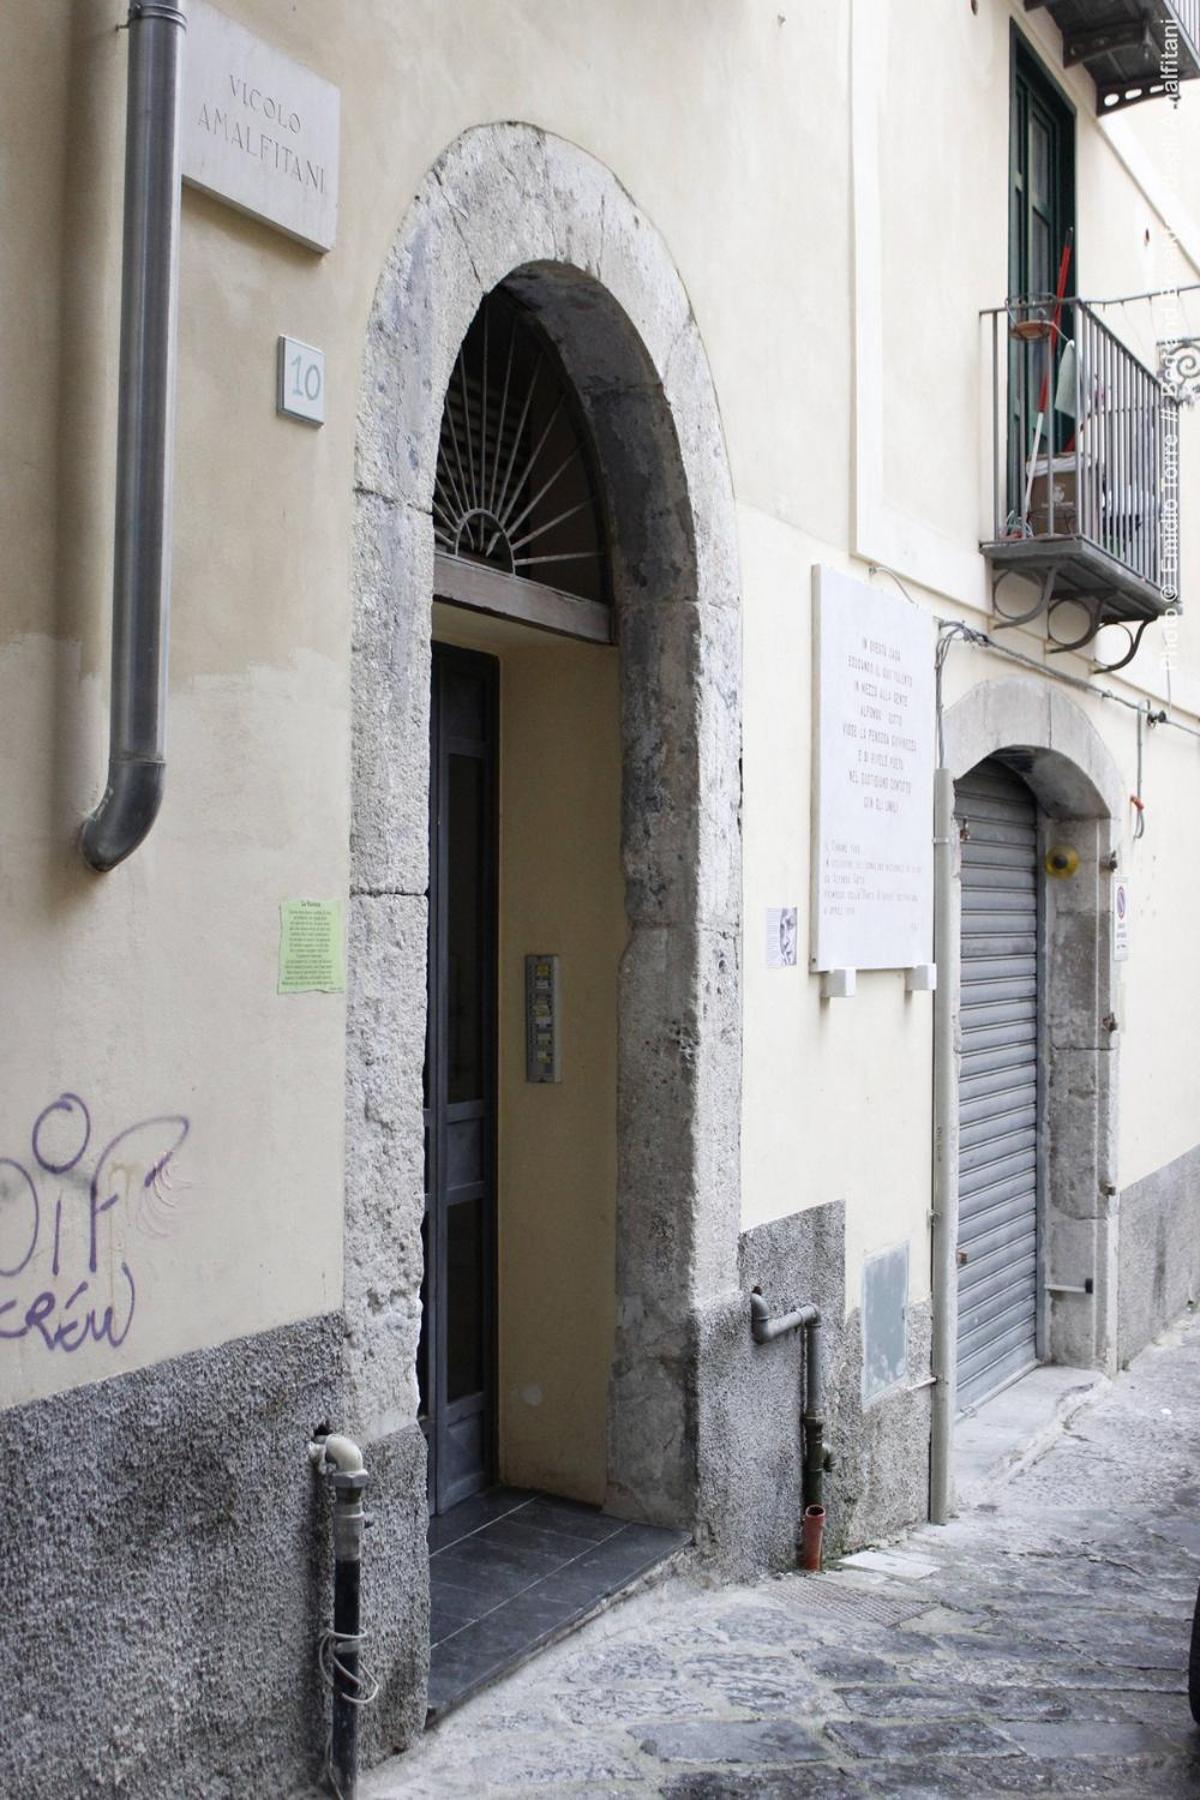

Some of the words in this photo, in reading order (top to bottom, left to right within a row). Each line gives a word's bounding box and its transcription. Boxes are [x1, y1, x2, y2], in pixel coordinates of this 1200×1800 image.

[229, 74, 302, 134] VICOLO
[198, 103, 325, 194] AMALFITANI
[291, 354, 322, 401] 10
